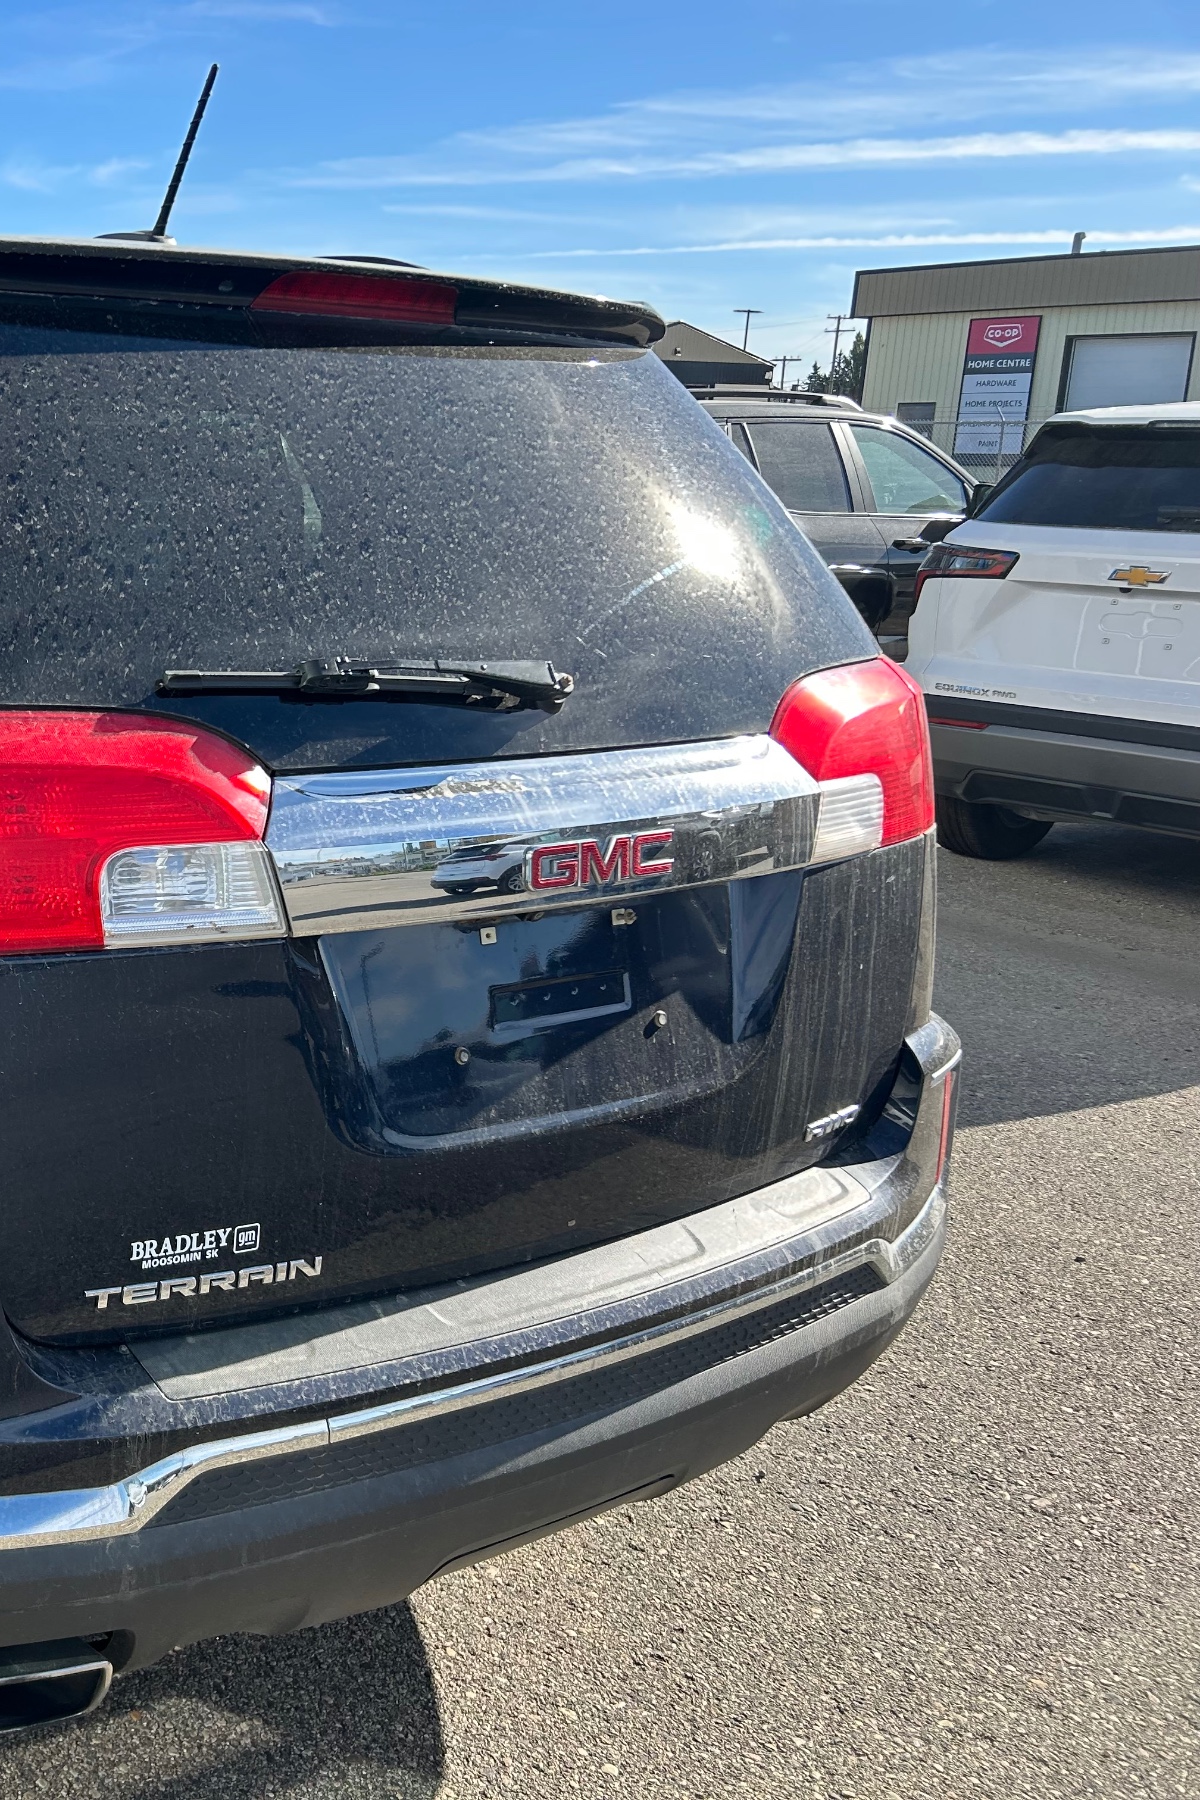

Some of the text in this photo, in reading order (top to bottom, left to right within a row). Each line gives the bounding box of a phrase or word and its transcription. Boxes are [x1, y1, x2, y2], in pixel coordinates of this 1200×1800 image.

[968, 359, 1031, 369] HOME CENTRE
[975, 379, 1017, 387] HARDWARE
[988, 400, 1023, 408] PROJECTS
[934, 682, 990, 697] EQUINOX
[526, 828, 675, 891] GMC
[130, 1227, 255, 1261] BRADLEY gm
[141, 1248, 219, 1269] MOOSOMIN SK
[84, 1256, 322, 1309] TERRAIN
